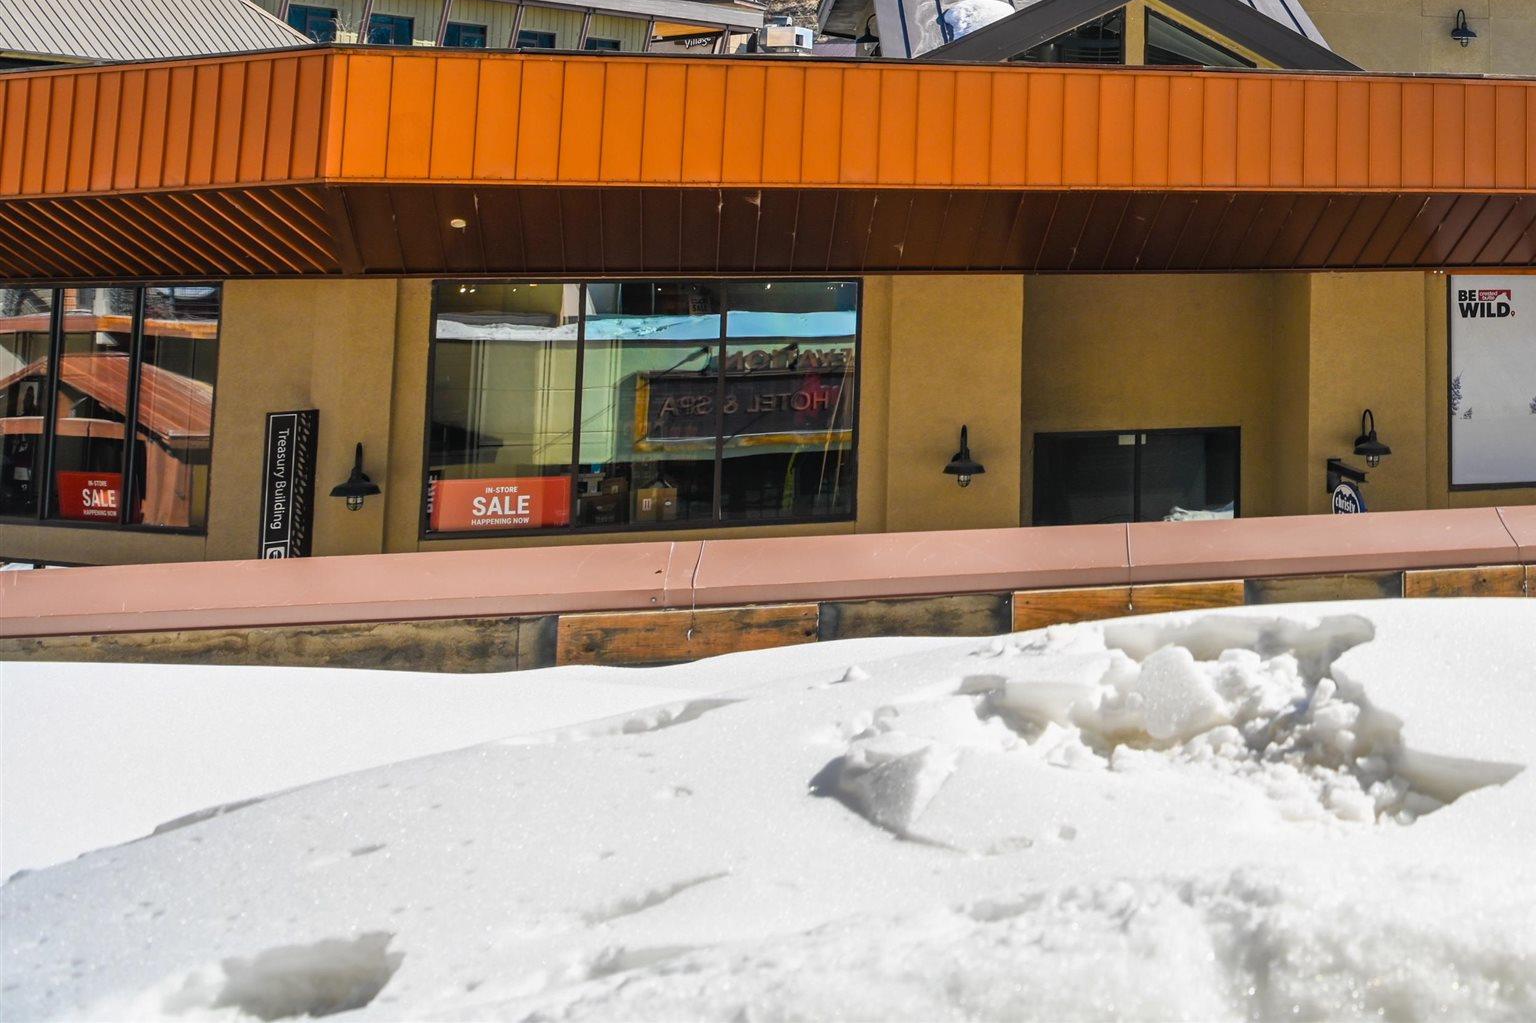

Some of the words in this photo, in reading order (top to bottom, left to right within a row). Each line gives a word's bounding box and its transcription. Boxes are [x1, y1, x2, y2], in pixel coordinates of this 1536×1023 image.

[1458, 289, 1477, 302] BE
[273, 428, 290, 478] Treasury
[82, 488, 117, 508] SALE
[485, 486, 518, 494] IN-STORE
[270, 480, 287, 530] Building
[472, 495, 531, 516] SALE
[471, 517, 512, 526] HAPPENING
[513, 517, 529, 525] NOW
